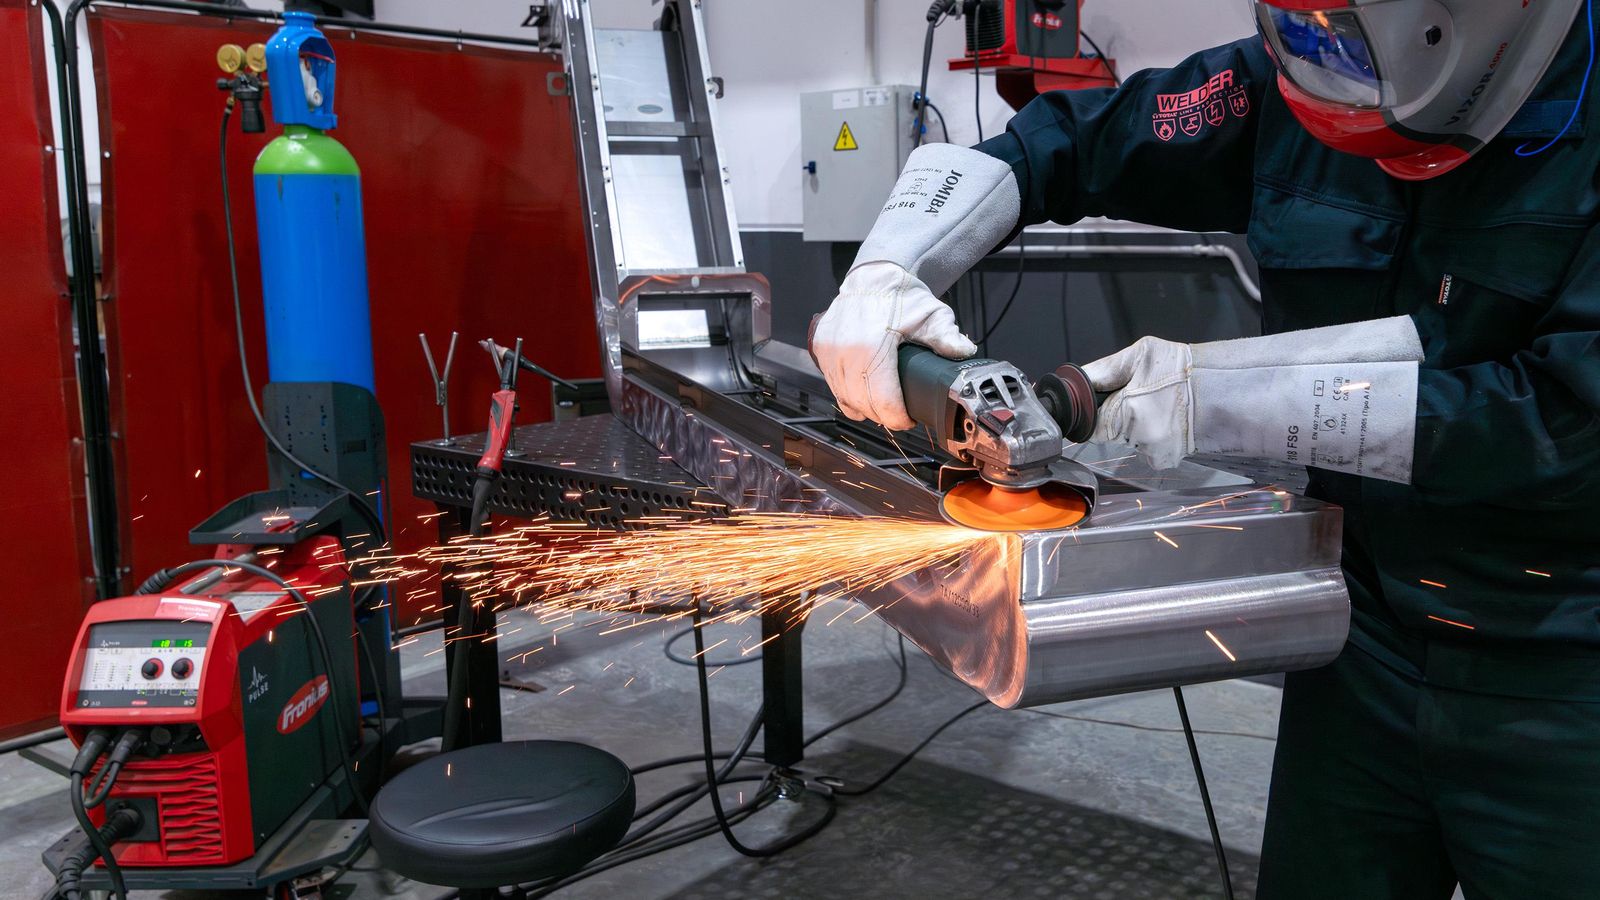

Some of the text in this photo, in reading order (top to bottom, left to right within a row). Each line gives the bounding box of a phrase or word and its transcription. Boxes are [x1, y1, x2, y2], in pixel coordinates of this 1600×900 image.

[1158, 69, 1233, 111] WELDER
[925, 169, 963, 214] JOMIBA
[1287, 425, 1299, 449] FSG
[1312, 432, 1318, 440] EN
[249, 682, 269, 704] PULSE
[282, 680, 329, 730] Fronius
